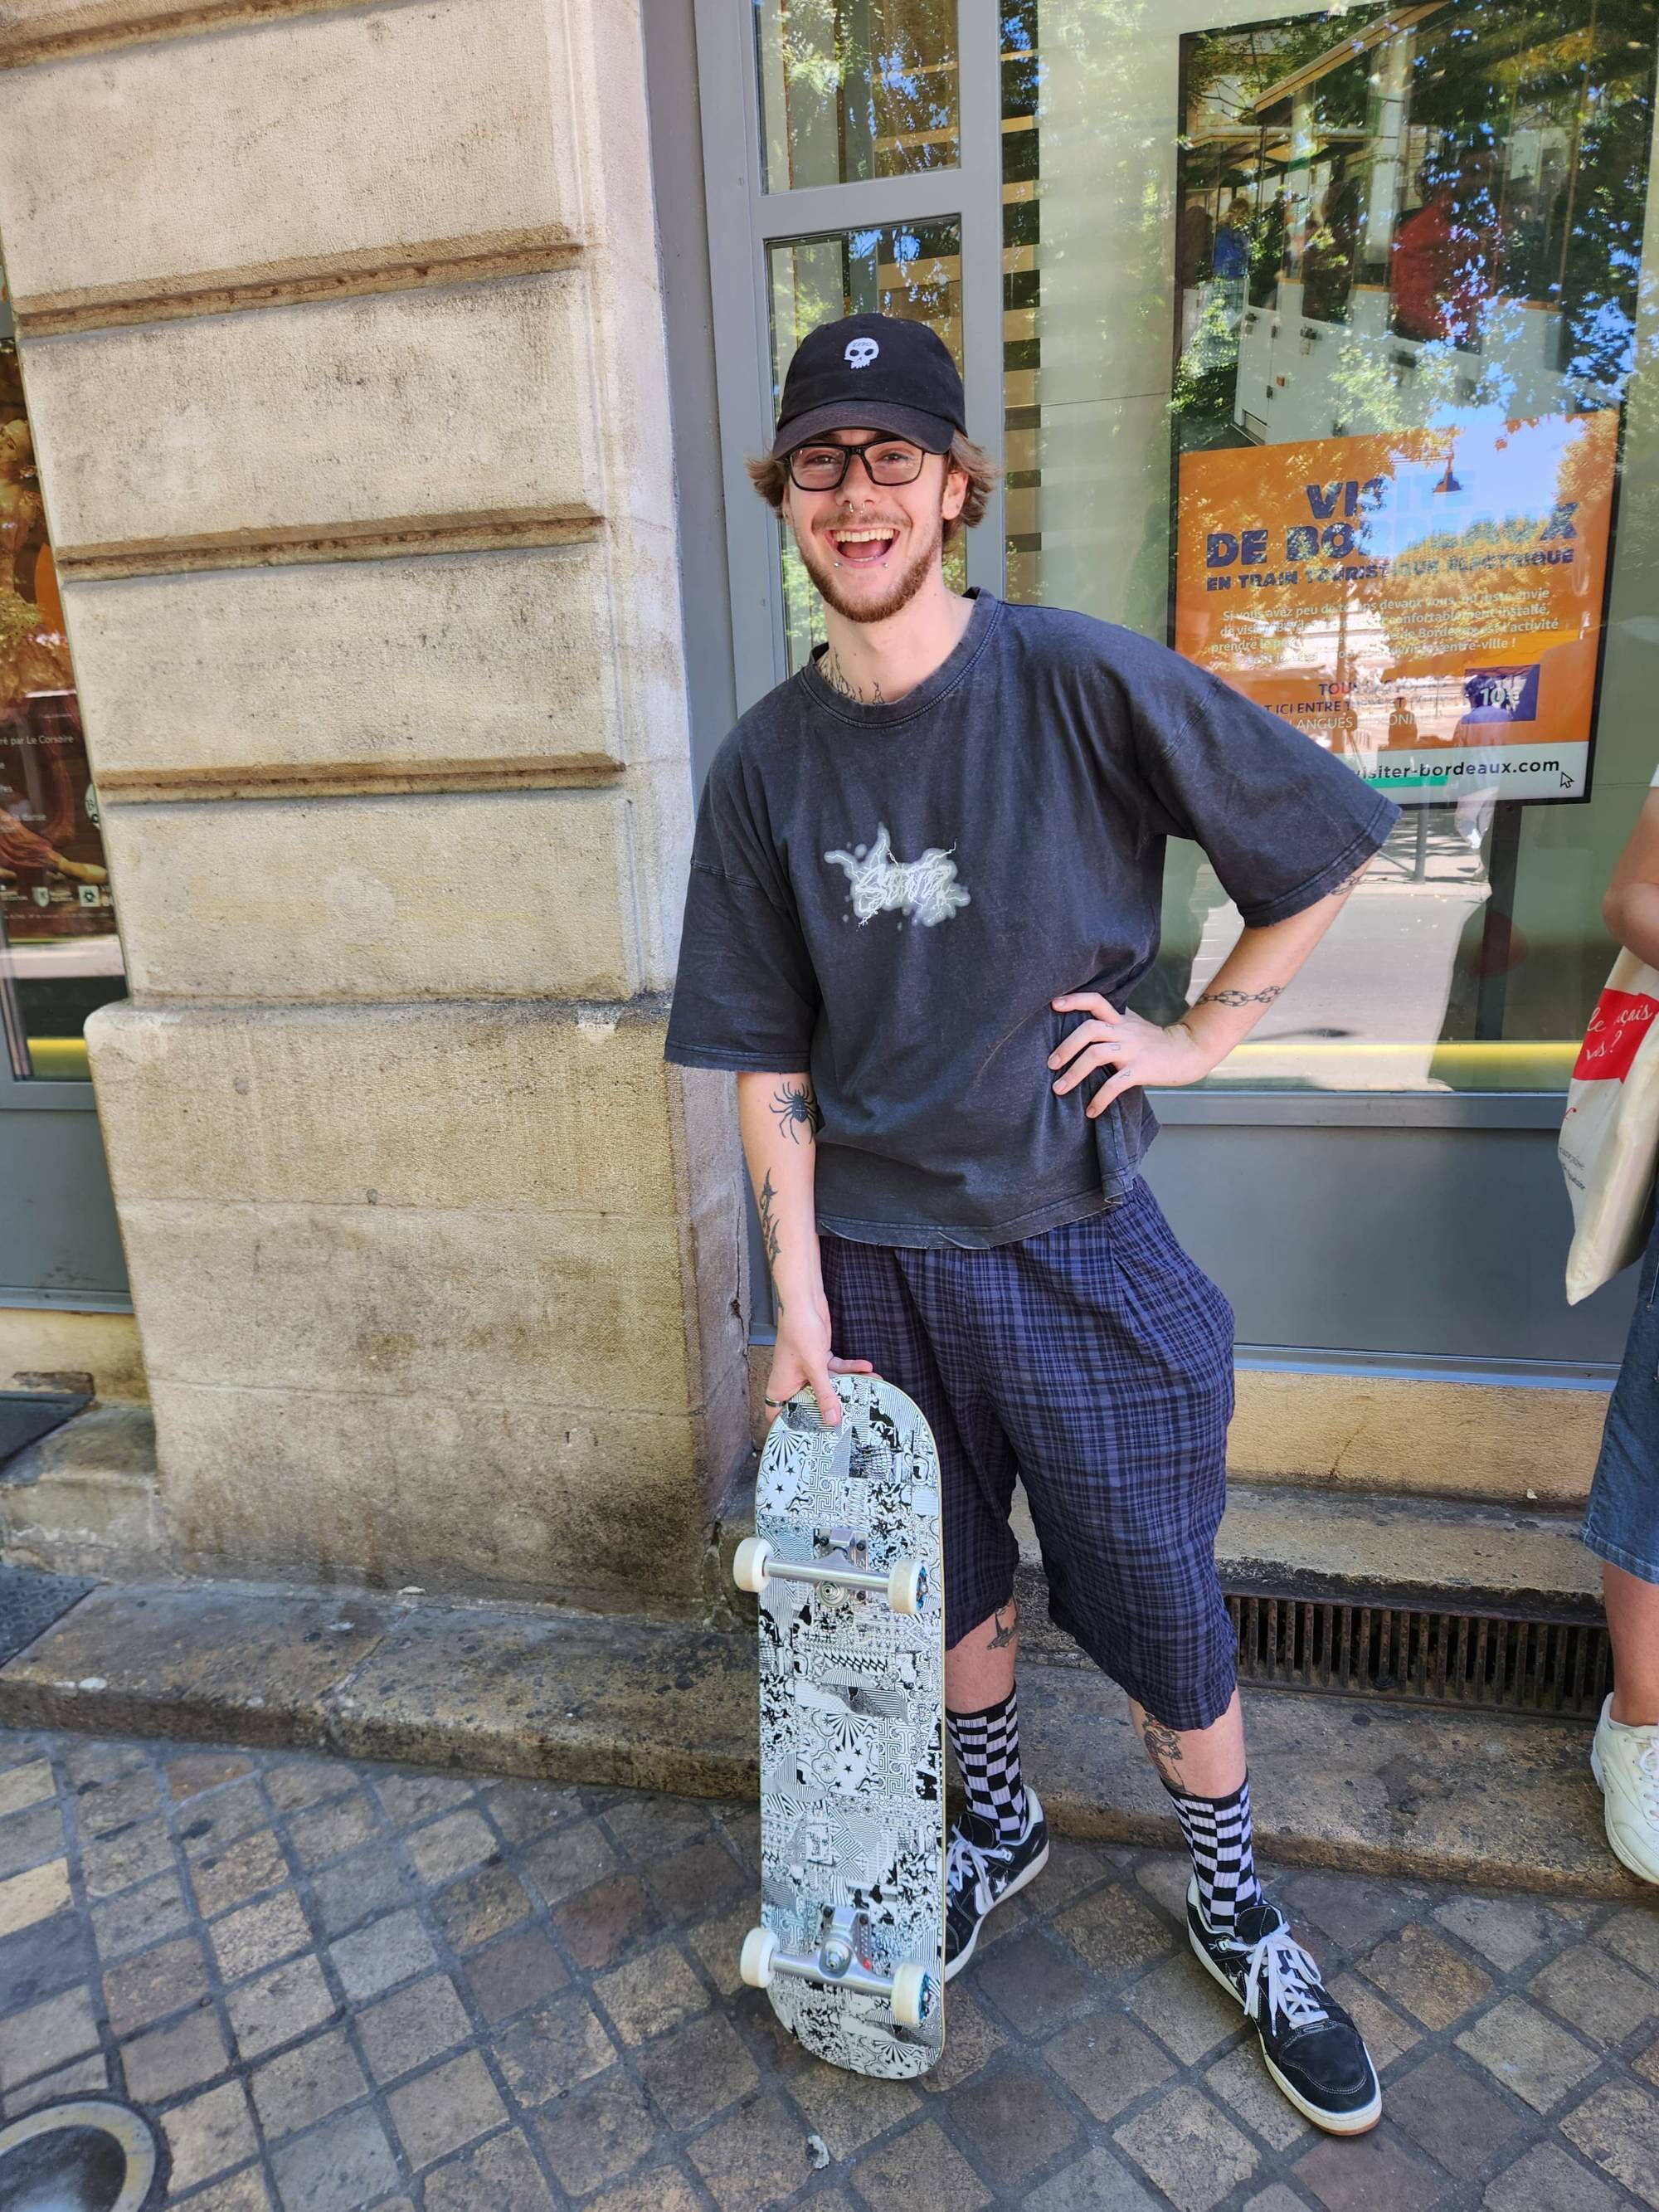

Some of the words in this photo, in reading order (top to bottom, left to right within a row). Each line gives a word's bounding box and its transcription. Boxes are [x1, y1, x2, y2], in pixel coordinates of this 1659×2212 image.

[1207, 529, 1268, 568] DE
[1207, 576, 1232, 591] EN
[1238, 570, 1298, 588] TRAIN
[1267, 608, 1292, 618] avez
[1297, 607, 1317, 618] peu
[1321, 604, 1335, 614] de
[1339, 601, 1377, 614] teps
[1211, 638, 1258, 653] prendre
[1276, 704, 1293, 714] ICI
[1297, 701, 1341, 714] ENTRE
